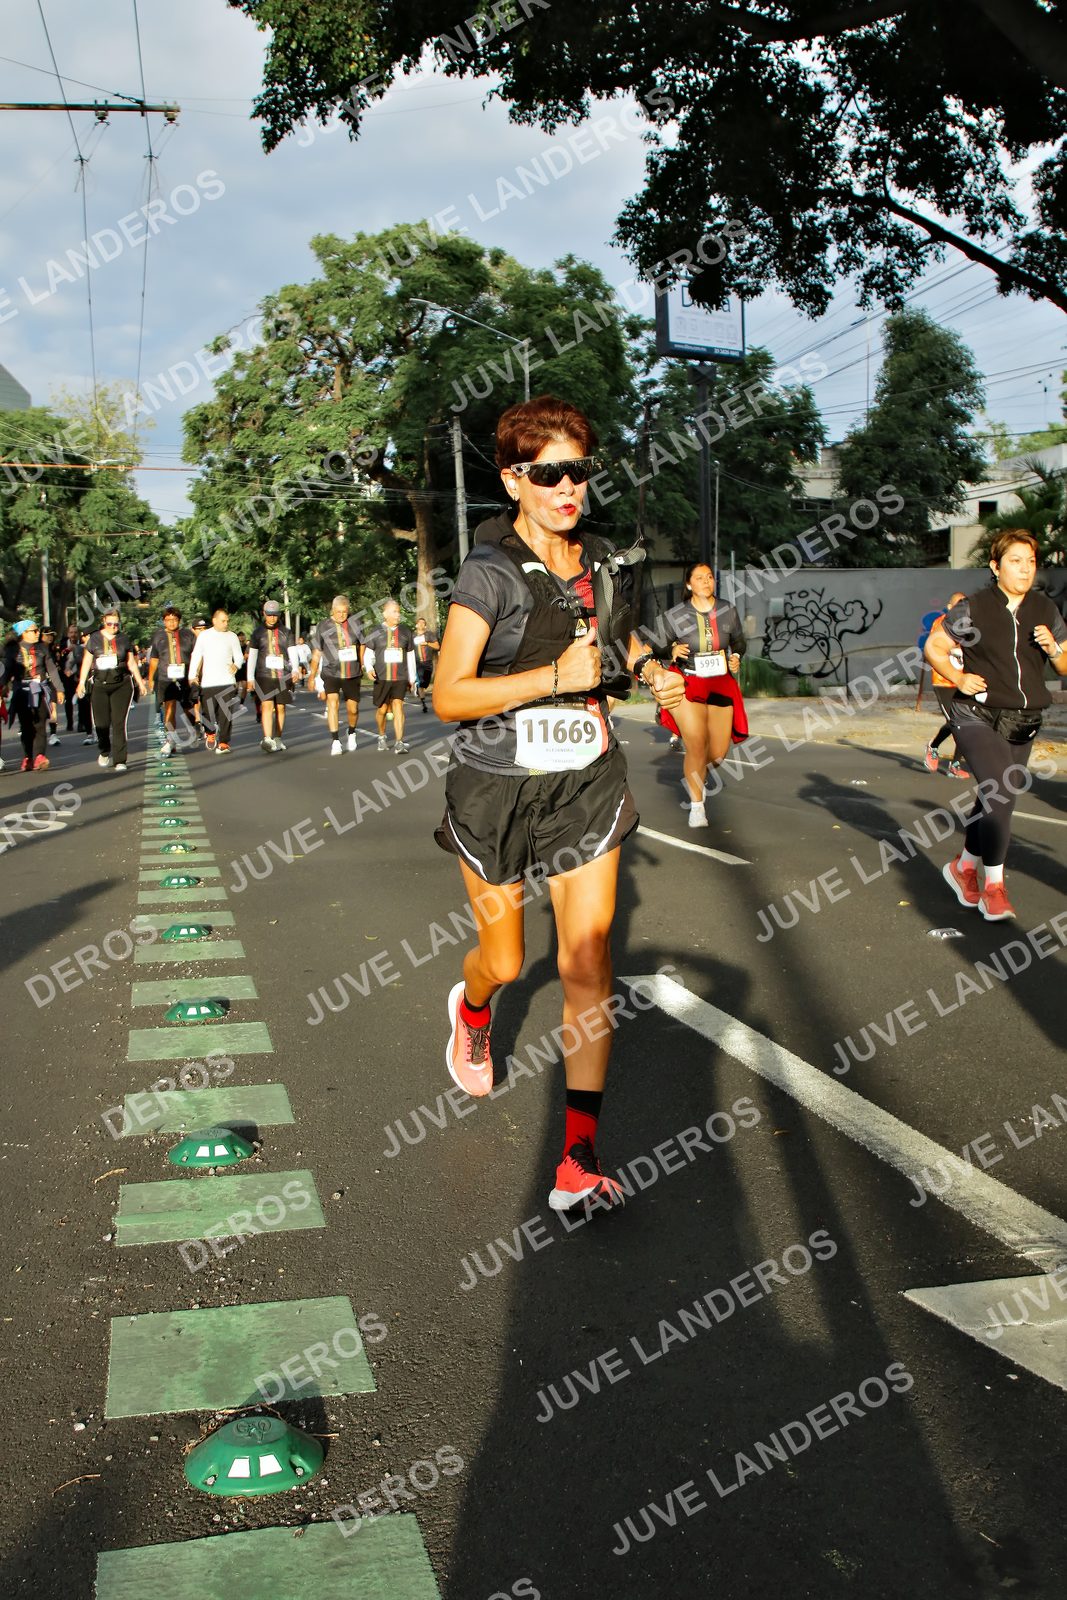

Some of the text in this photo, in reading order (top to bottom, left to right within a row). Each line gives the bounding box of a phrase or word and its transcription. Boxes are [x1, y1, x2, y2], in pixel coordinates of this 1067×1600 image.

[785, 587, 825, 602] TOY
[700, 658, 720, 669] 5991
[522, 719, 597, 744] 11669
